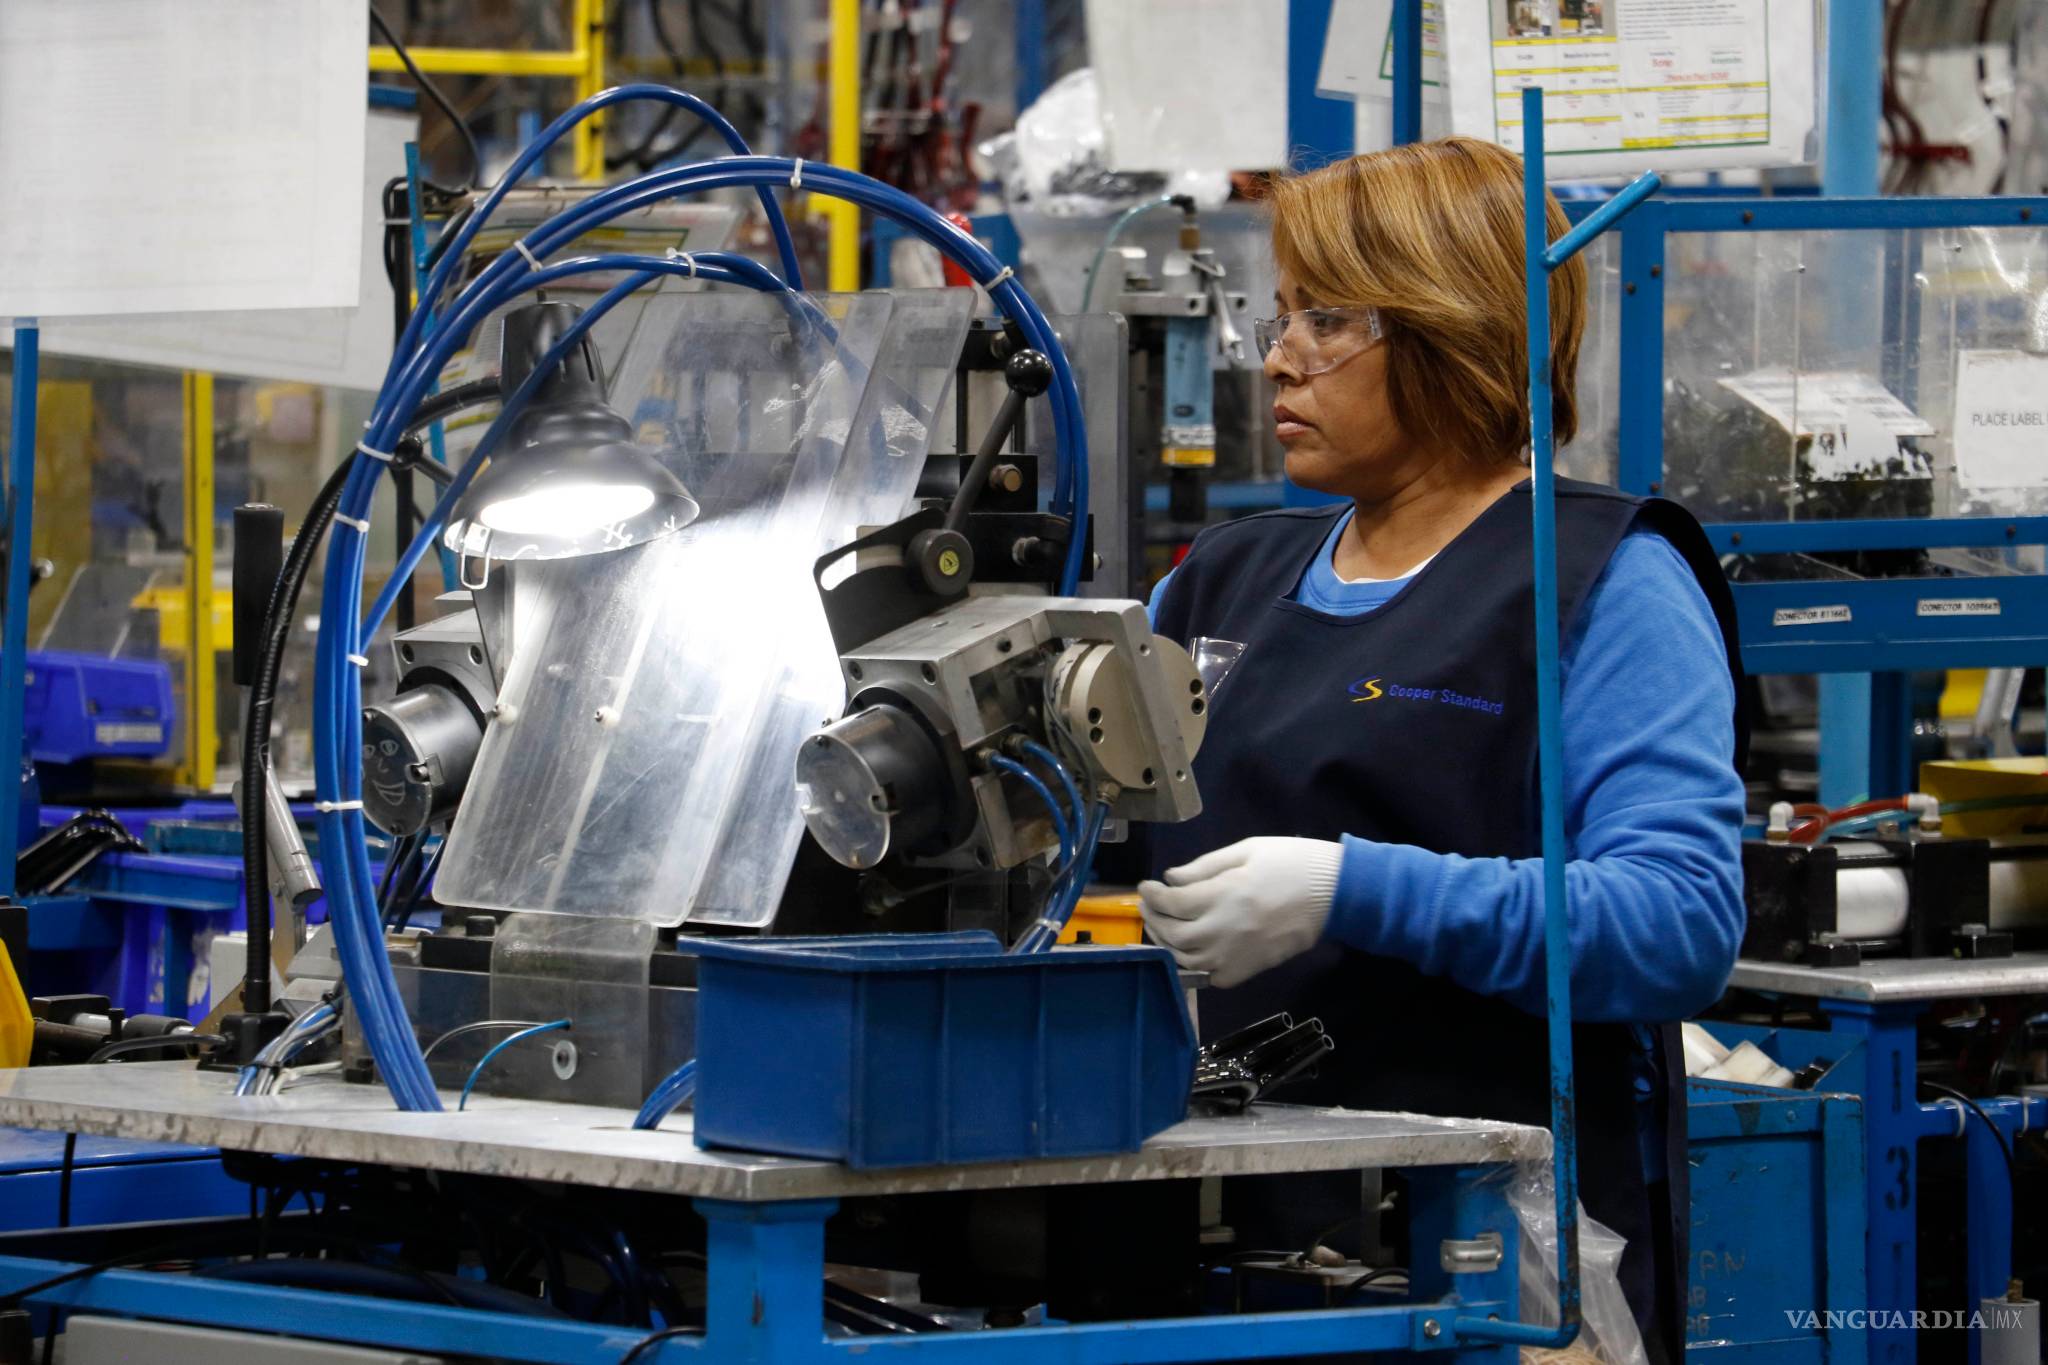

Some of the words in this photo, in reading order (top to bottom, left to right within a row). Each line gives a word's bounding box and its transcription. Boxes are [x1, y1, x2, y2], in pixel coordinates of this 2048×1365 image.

[1972, 412, 2009, 427] PLACE
[2011, 412, 2045, 426] LABEL
[1388, 684, 1435, 700] Cooper
[1440, 689, 1504, 715] Standard
